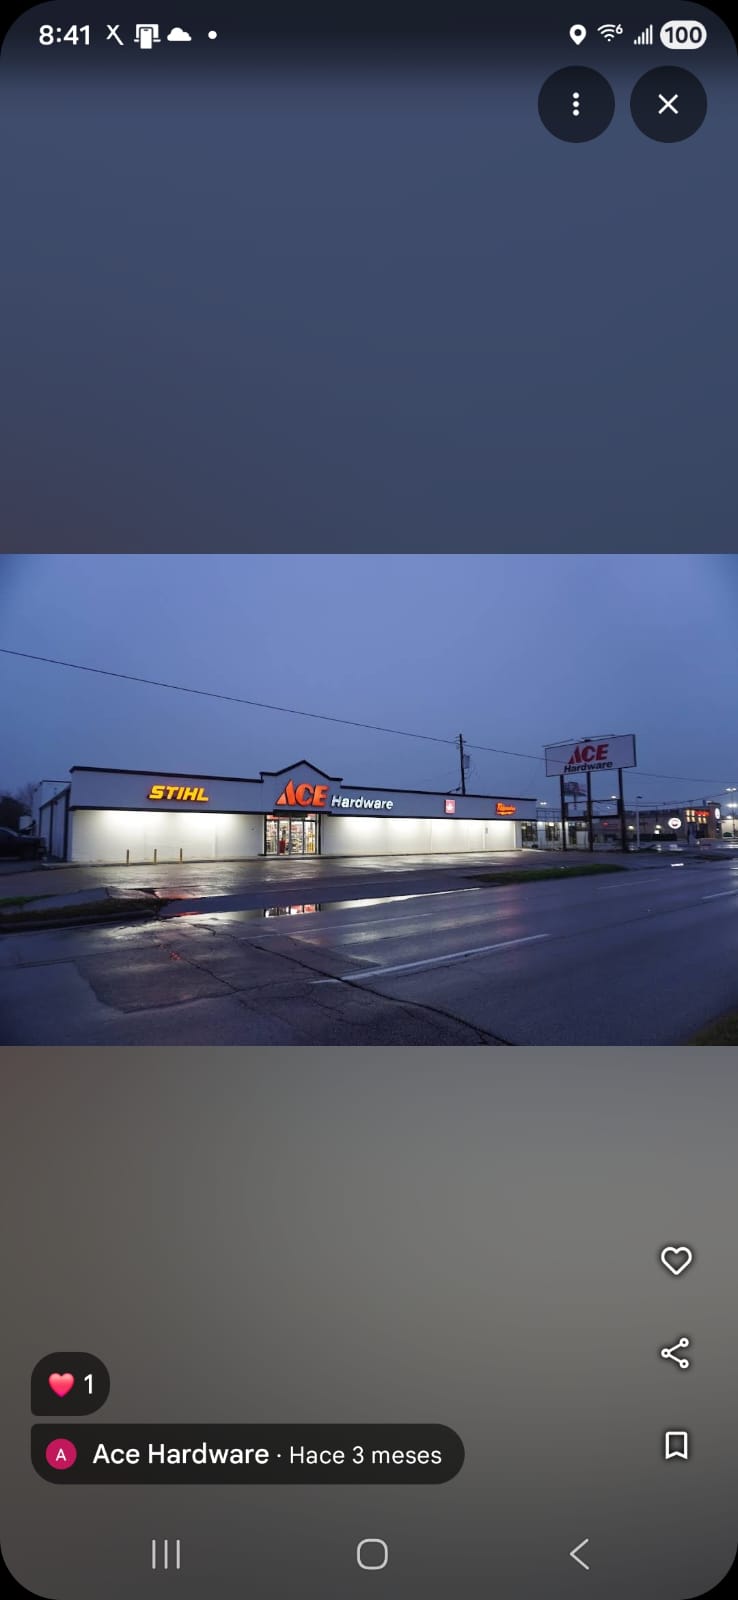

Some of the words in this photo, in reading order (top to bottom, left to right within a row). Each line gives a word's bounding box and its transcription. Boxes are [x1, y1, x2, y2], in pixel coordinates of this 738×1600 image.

[567, 742, 609, 765] ACE
[563, 761, 613, 773] Hardware
[148, 784, 209, 802] STIHL
[276, 779, 330, 807] ACE
[331, 794, 394, 810] Hardware
